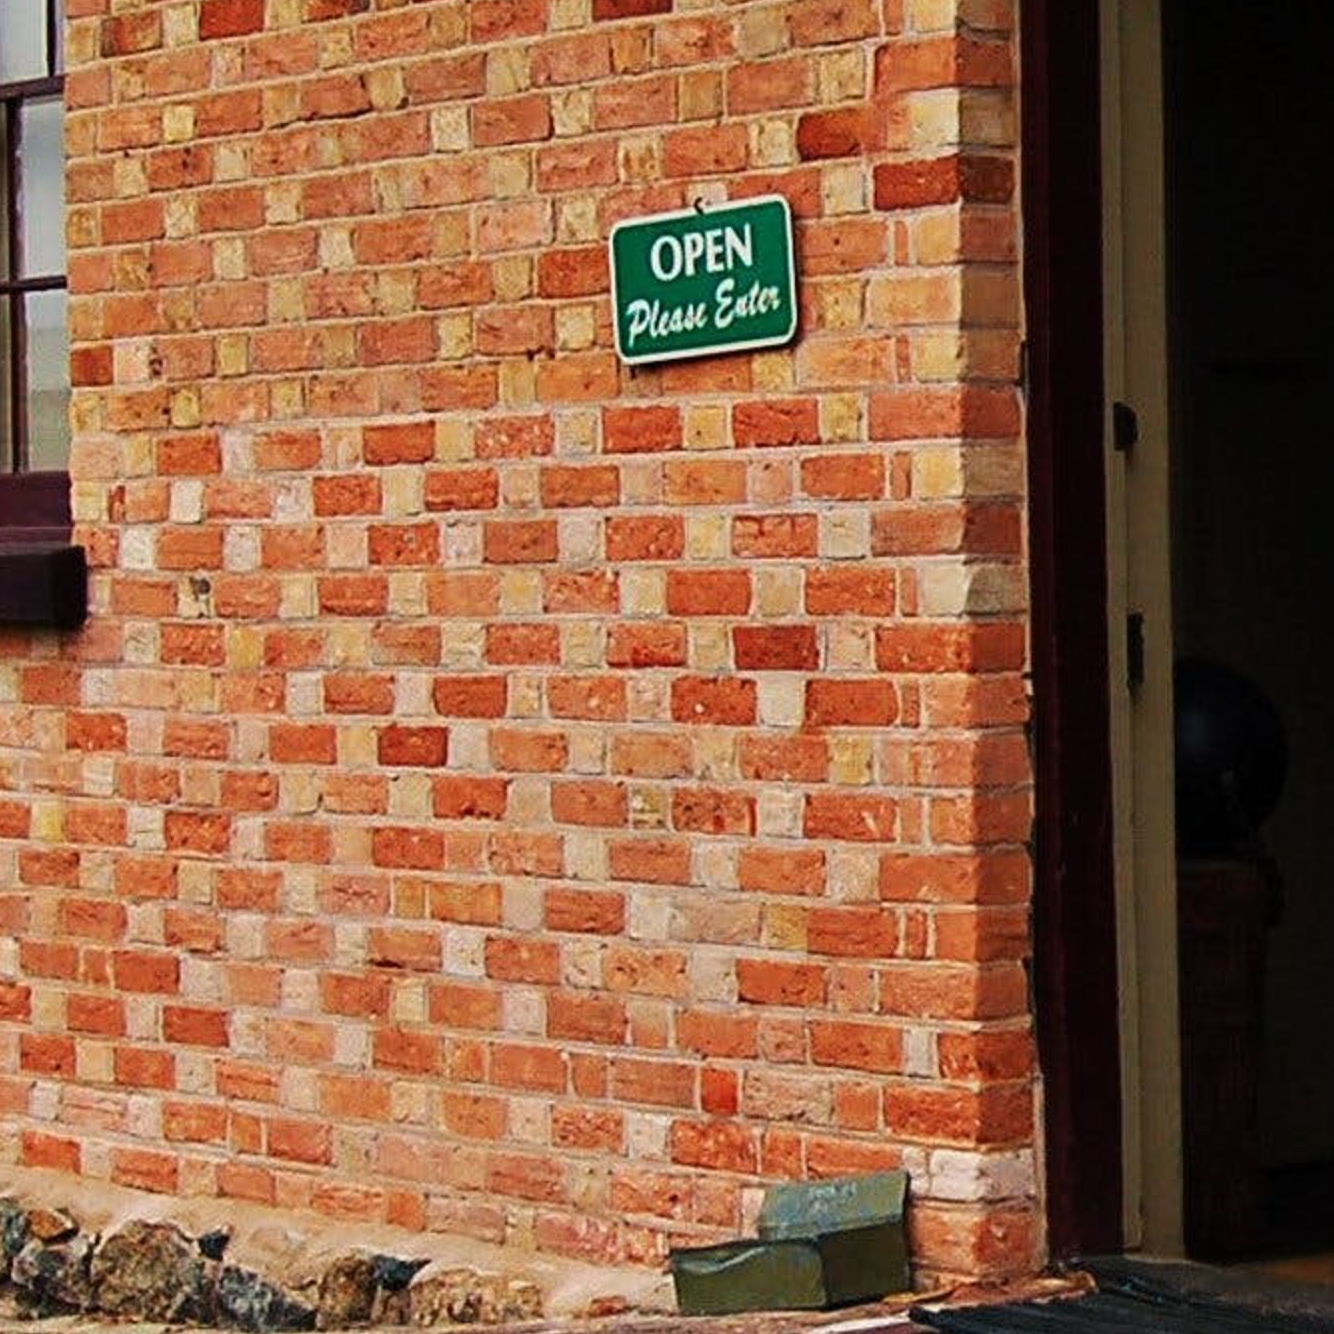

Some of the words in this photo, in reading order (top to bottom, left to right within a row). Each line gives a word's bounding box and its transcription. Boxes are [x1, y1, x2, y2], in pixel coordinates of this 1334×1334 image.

[651, 223, 753, 281] OPEN
[627, 299, 707, 348] Please
[714, 278, 780, 328] Enter
